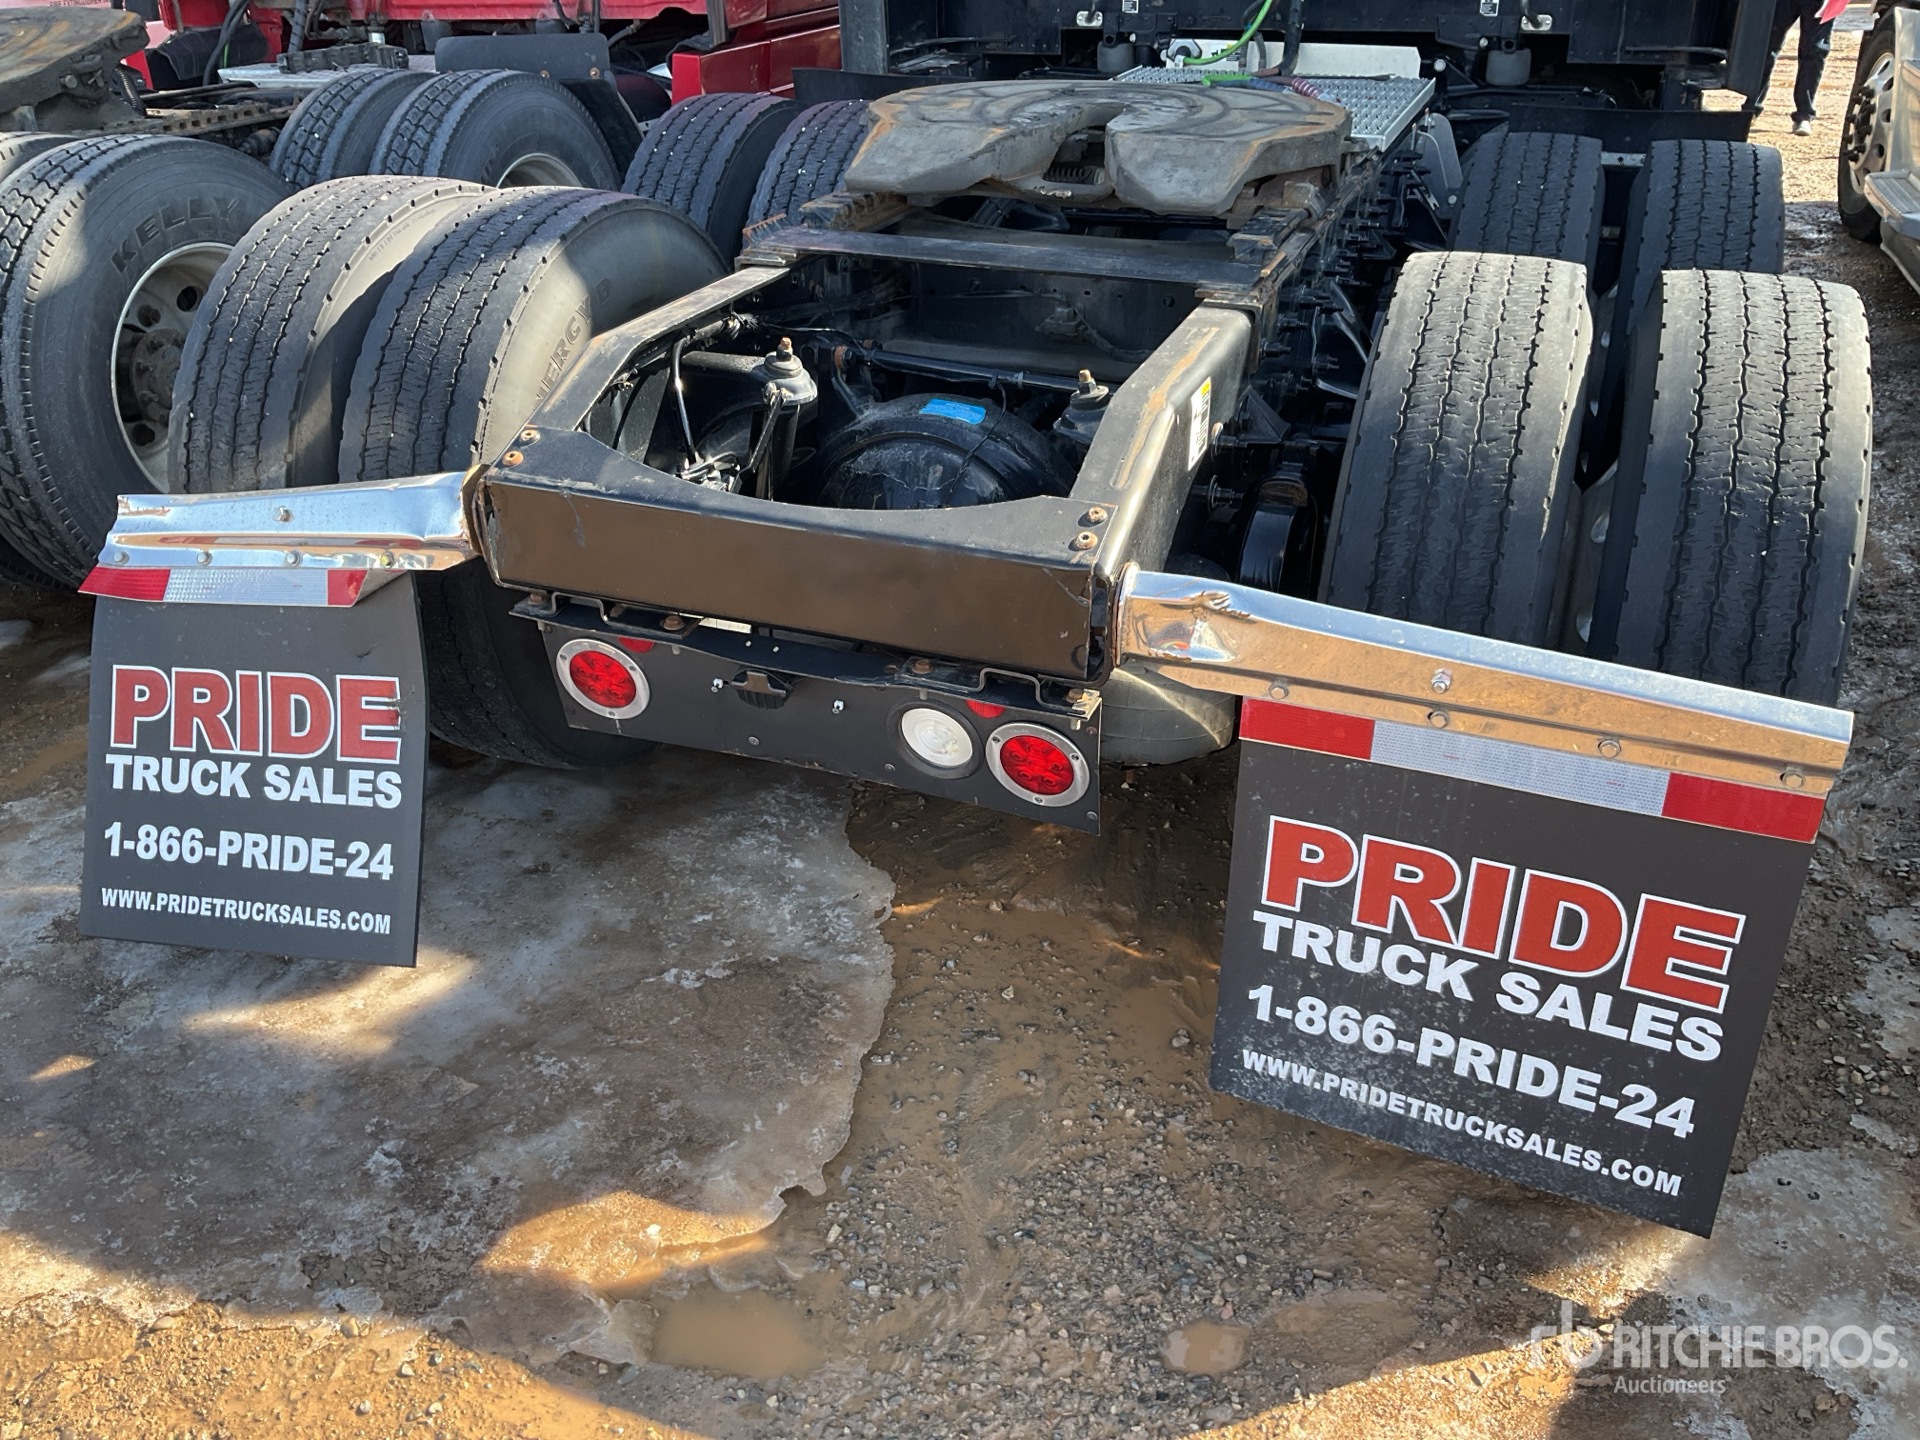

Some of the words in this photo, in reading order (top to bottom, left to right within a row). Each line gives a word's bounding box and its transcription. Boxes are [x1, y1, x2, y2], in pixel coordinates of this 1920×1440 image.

[111, 197, 240, 274] KELLY
[110, 665, 402, 764] PRIDE
[106, 754, 251, 798] TRUCK
[264, 764, 402, 809] SALES
[104, 822, 393, 880] 1-866-PRIDE-24
[101, 887, 390, 934] WWW.PRIDETRUCKSALES.COM
[1261, 815, 1746, 1015] PRIDE
[1253, 910, 1479, 1002] TRUCK
[1496, 972, 1723, 1061] SALES
[1247, 984, 1695, 1138] 1-866-PRIDE-24
[1242, 1049, 1683, 1196] WWW.PRIDETRUCKSALES.COM
